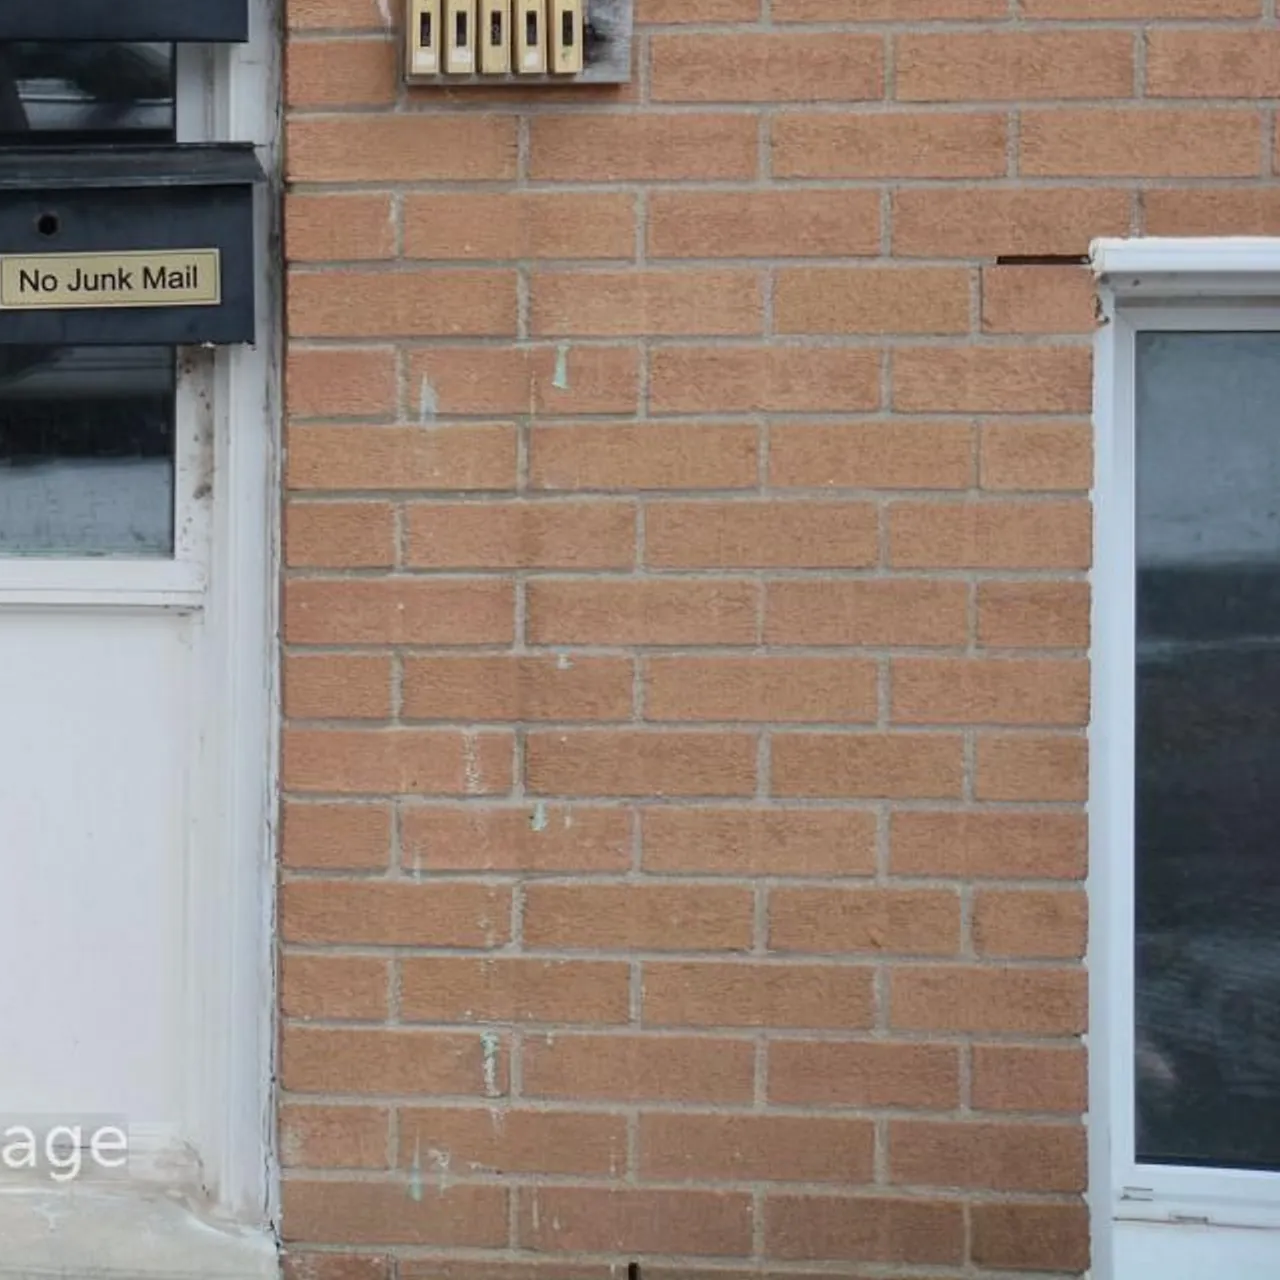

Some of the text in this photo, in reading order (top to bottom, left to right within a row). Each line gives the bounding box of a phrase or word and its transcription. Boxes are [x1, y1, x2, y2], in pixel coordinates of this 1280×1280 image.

[19, 265, 198, 292] No Junk Mail
